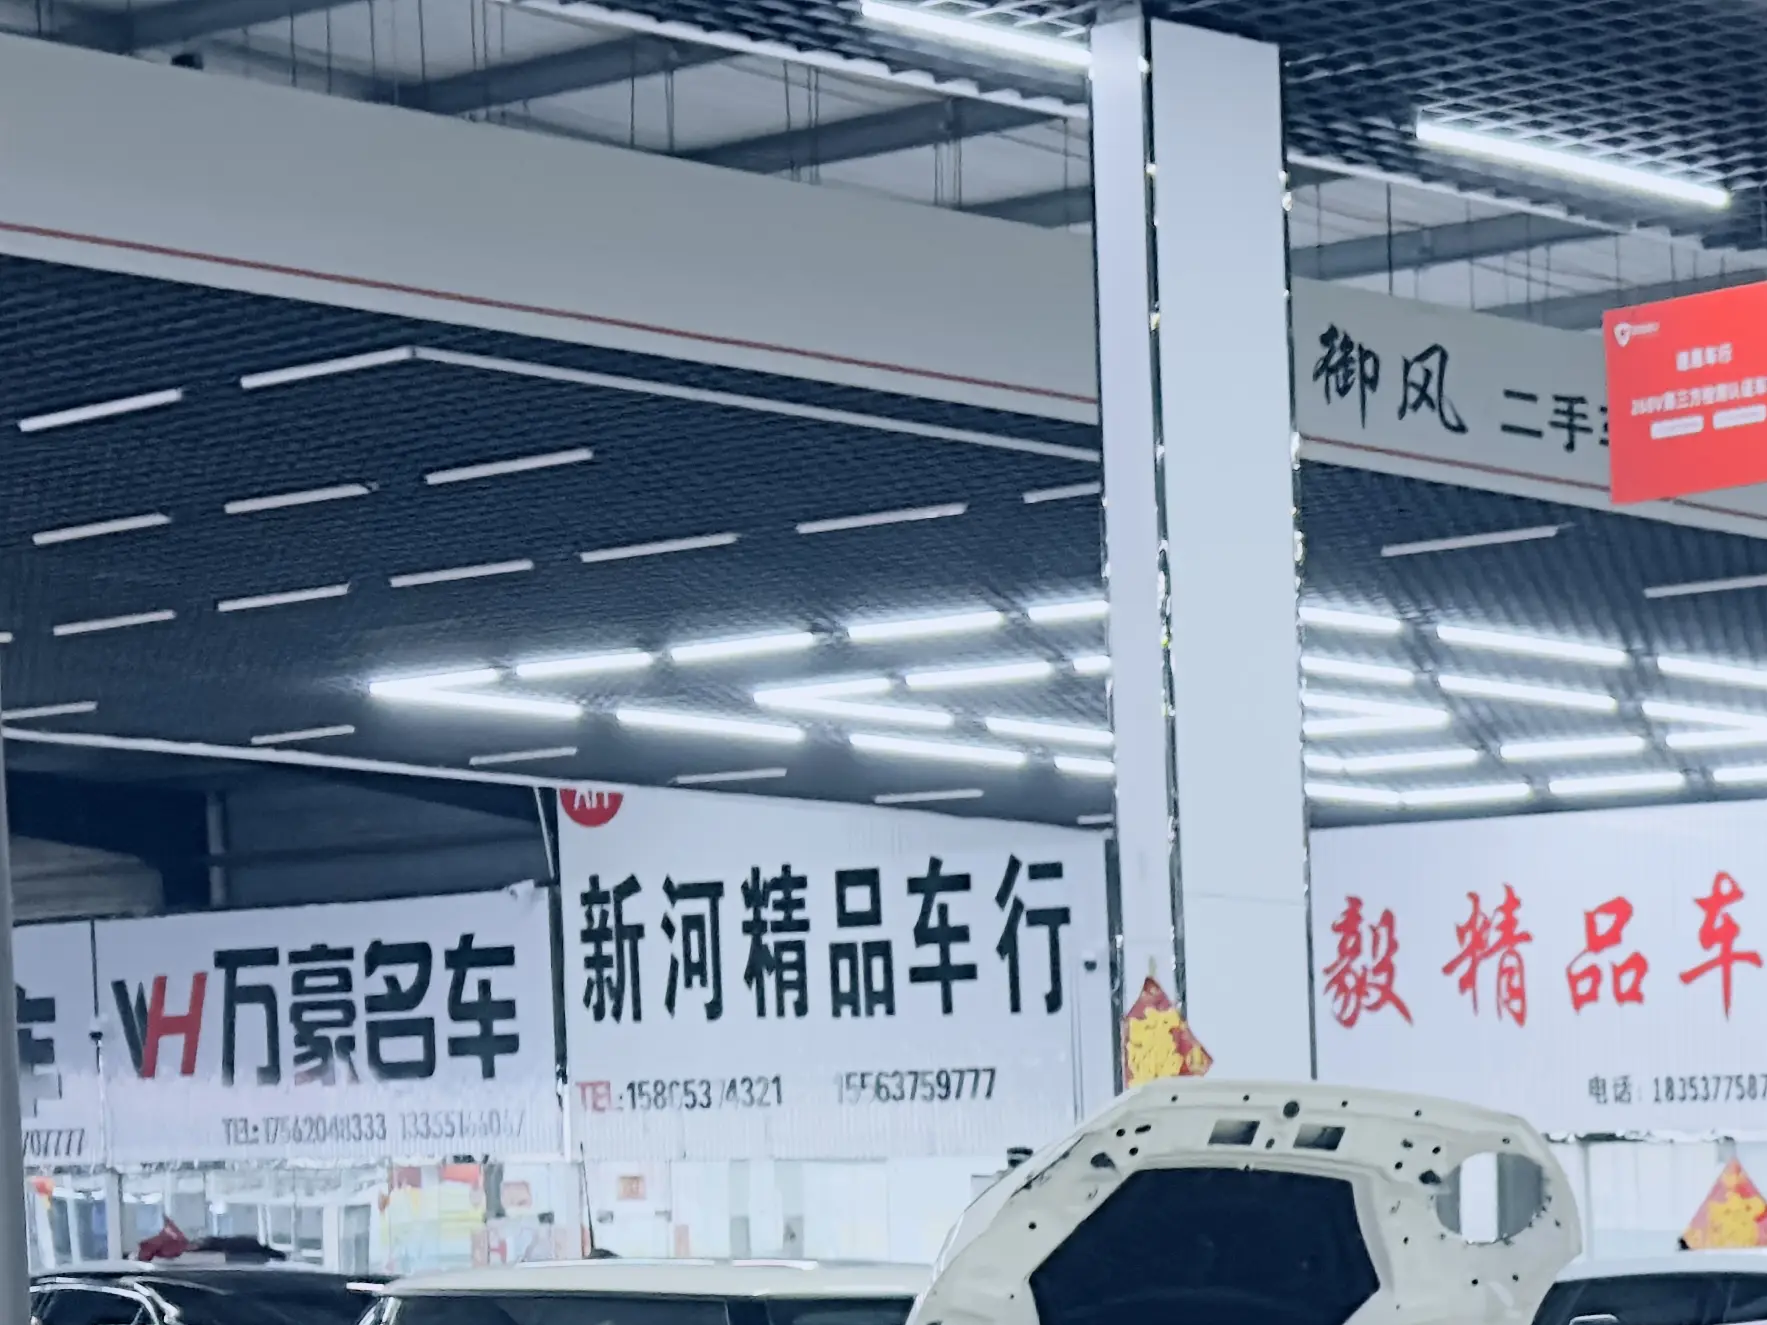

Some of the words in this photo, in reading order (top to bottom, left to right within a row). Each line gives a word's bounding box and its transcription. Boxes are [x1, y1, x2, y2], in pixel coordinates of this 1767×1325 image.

[1312, 322, 1468, 434] 御风
[1501, 387, 1611, 453] 二手
[213, 932, 521, 1087] 万豪名车
[579, 853, 1071, 1024] 新河精品车行
